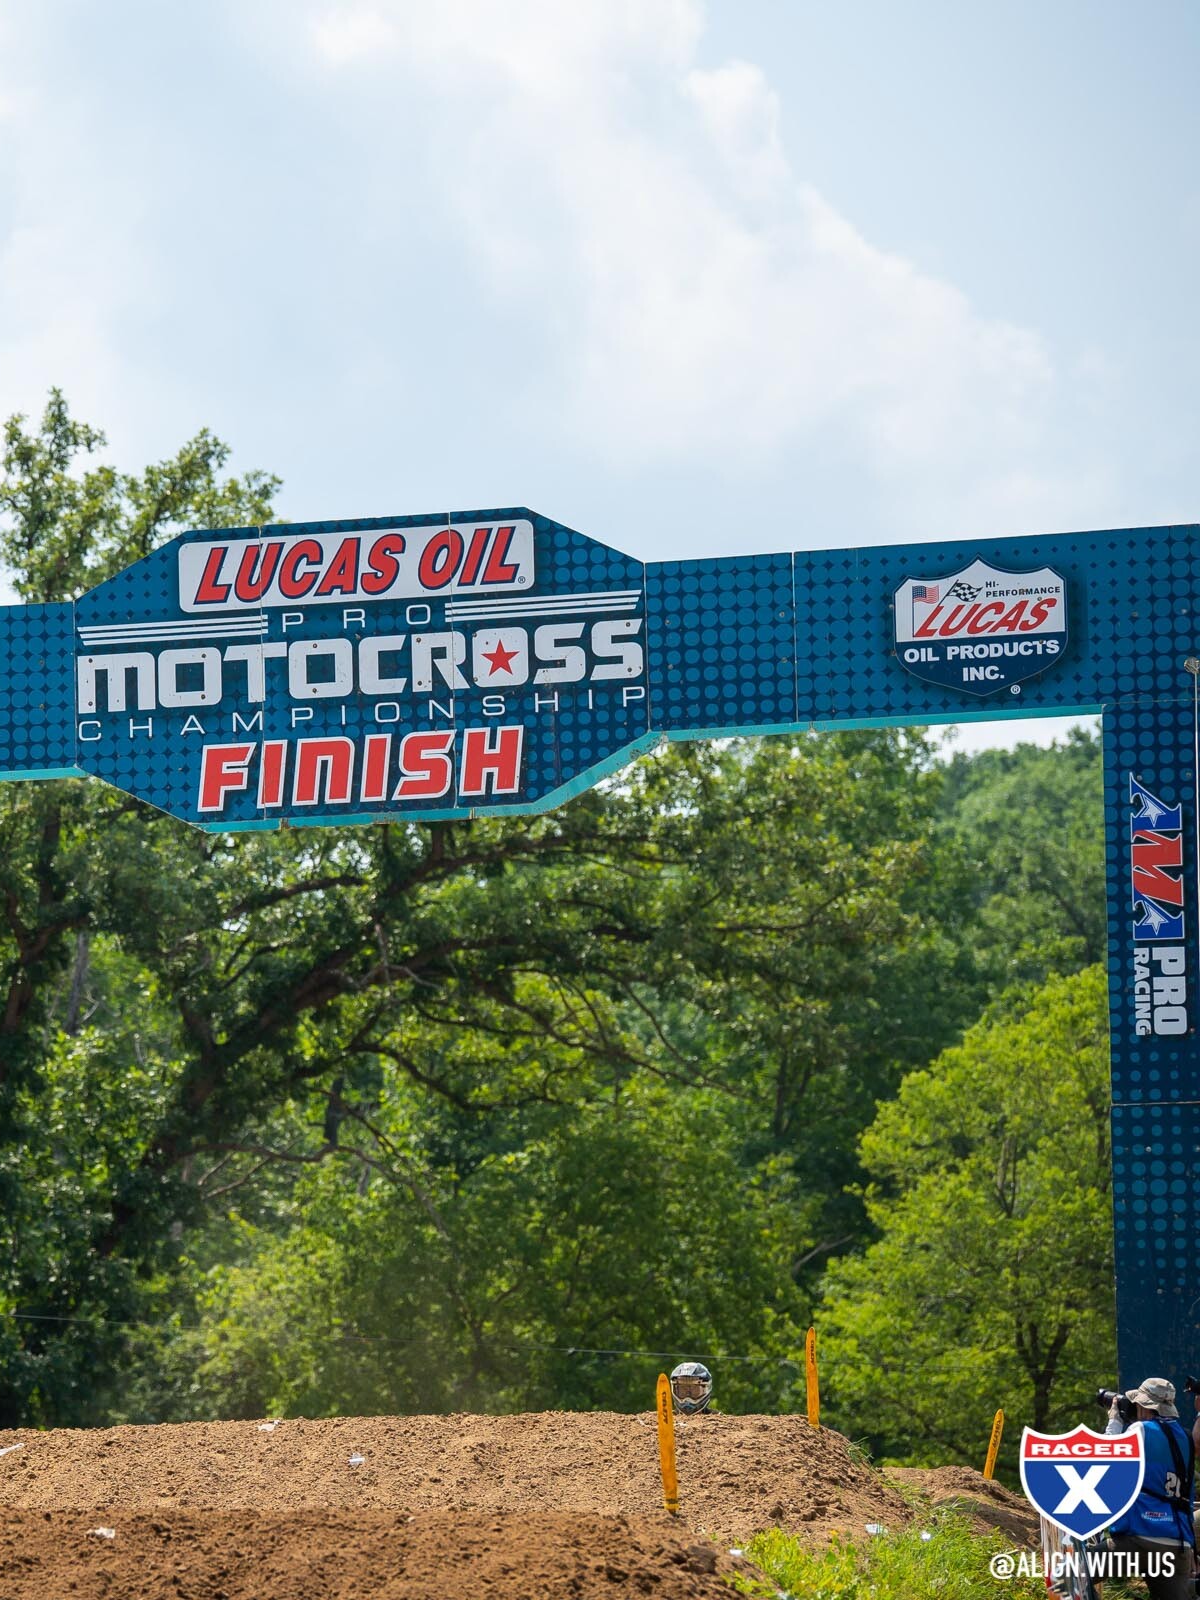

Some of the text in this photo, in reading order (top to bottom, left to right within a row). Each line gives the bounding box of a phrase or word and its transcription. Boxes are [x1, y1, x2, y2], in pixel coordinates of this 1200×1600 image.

[193, 526, 520, 605] LUCAS OIL
[985, 586, 1061, 598] PERFORMANCE
[282, 604, 431, 632] PRO
[913, 598, 1057, 638] LUCAS
[77, 619, 643, 714] MOTOCROSS
[904, 640, 1060, 663] OIL PRODUCTS
[962, 666, 1005, 681] INC.
[79, 686, 645, 742] CHAMPIONSHIP
[197, 725, 525, 812] FINISH
[1133, 947, 1152, 1036] RACING
[1151, 946, 1188, 1035] PRO
